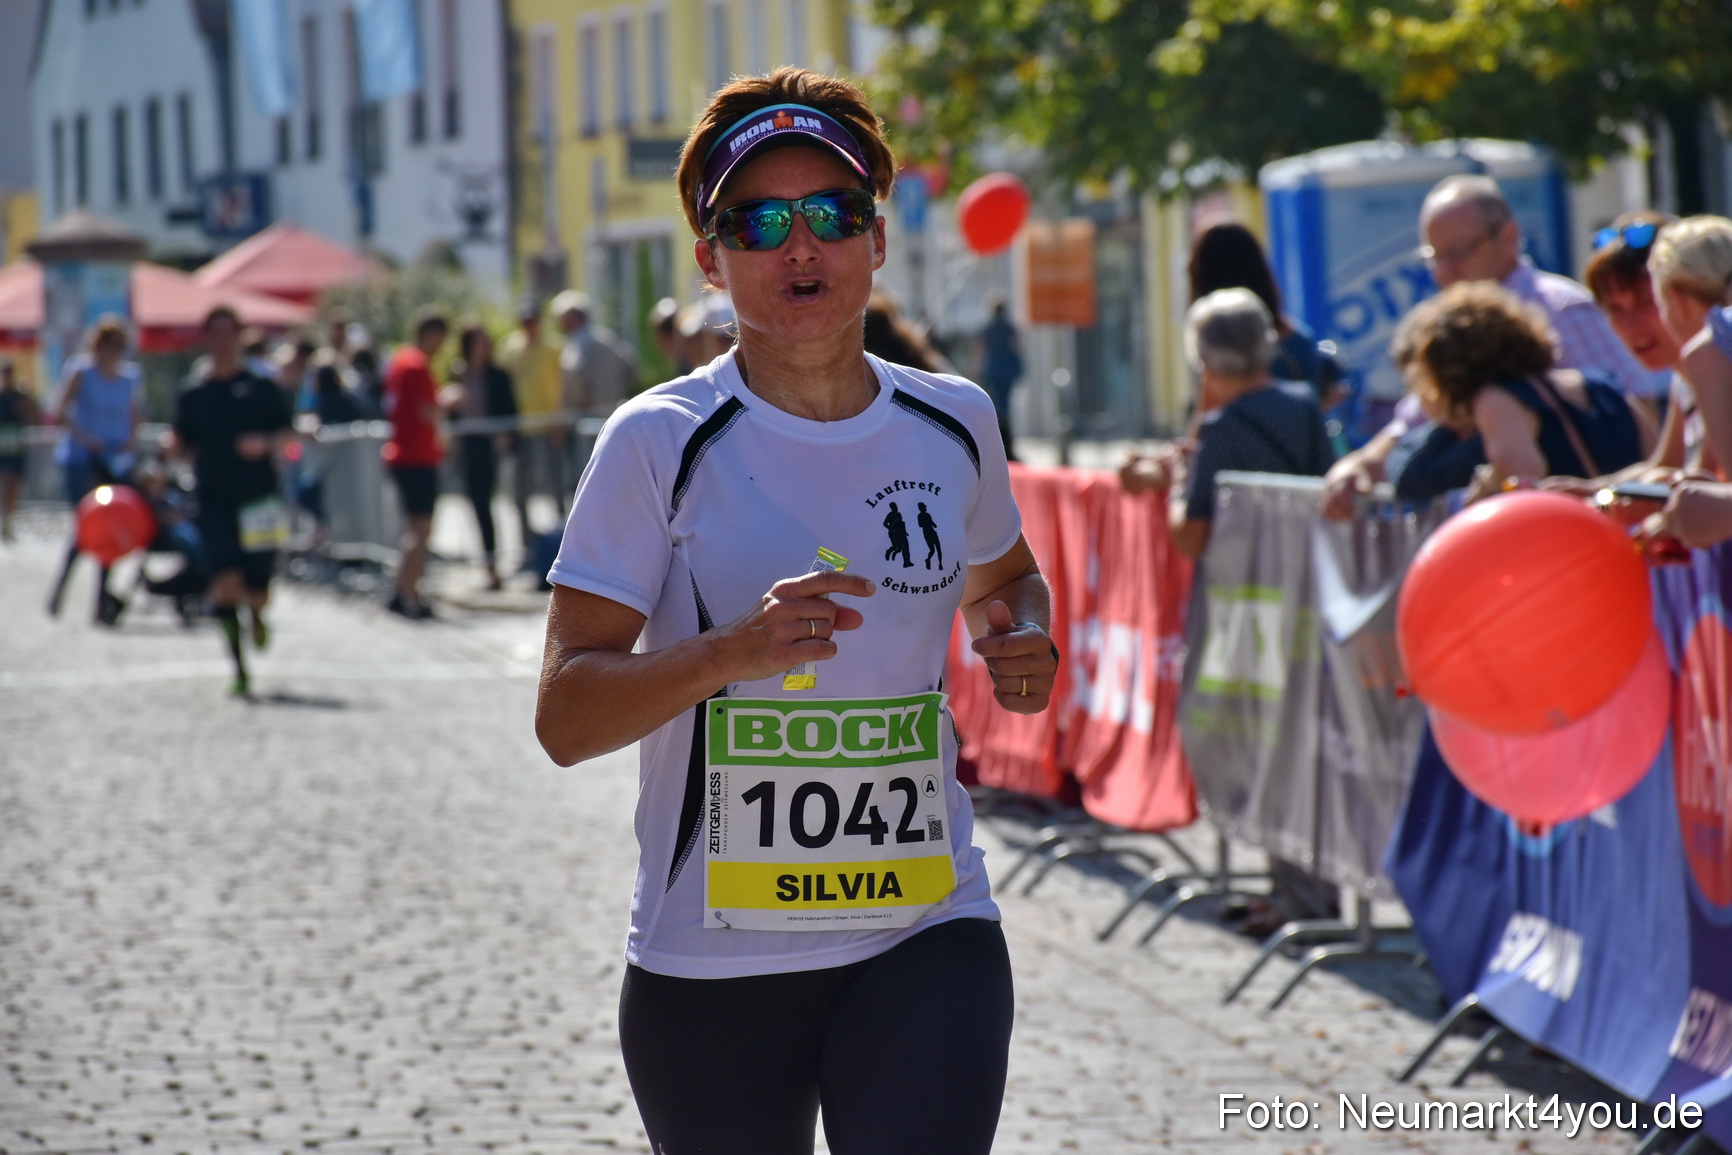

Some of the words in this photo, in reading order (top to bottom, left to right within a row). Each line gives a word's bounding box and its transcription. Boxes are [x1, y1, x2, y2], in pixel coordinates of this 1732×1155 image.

[729, 112, 822, 153] IRONMAN
[865, 479, 942, 509] Lauftreff
[881, 561, 962, 595] Schwandorf
[728, 703, 926, 758] BOCK
[926, 780, 935, 792] A
[741, 777, 925, 849] 1042
[776, 871, 903, 902] SILVIA
